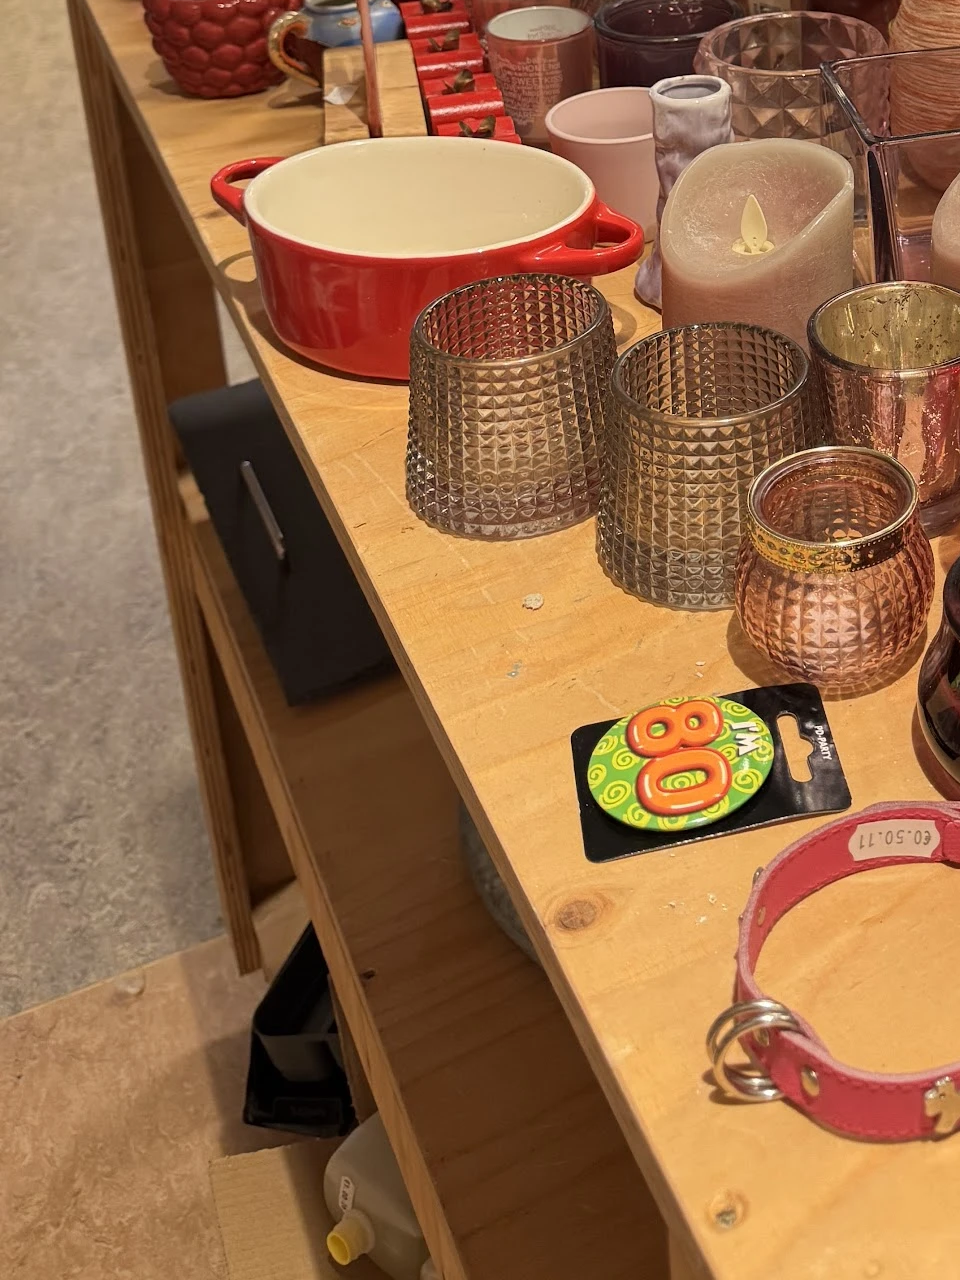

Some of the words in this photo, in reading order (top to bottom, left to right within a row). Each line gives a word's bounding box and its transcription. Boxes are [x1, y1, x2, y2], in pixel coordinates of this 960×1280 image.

[730, 721, 761, 756] I'M
[625, 699, 733, 817] 80
[859, 829, 932, 850] €0.50.11
